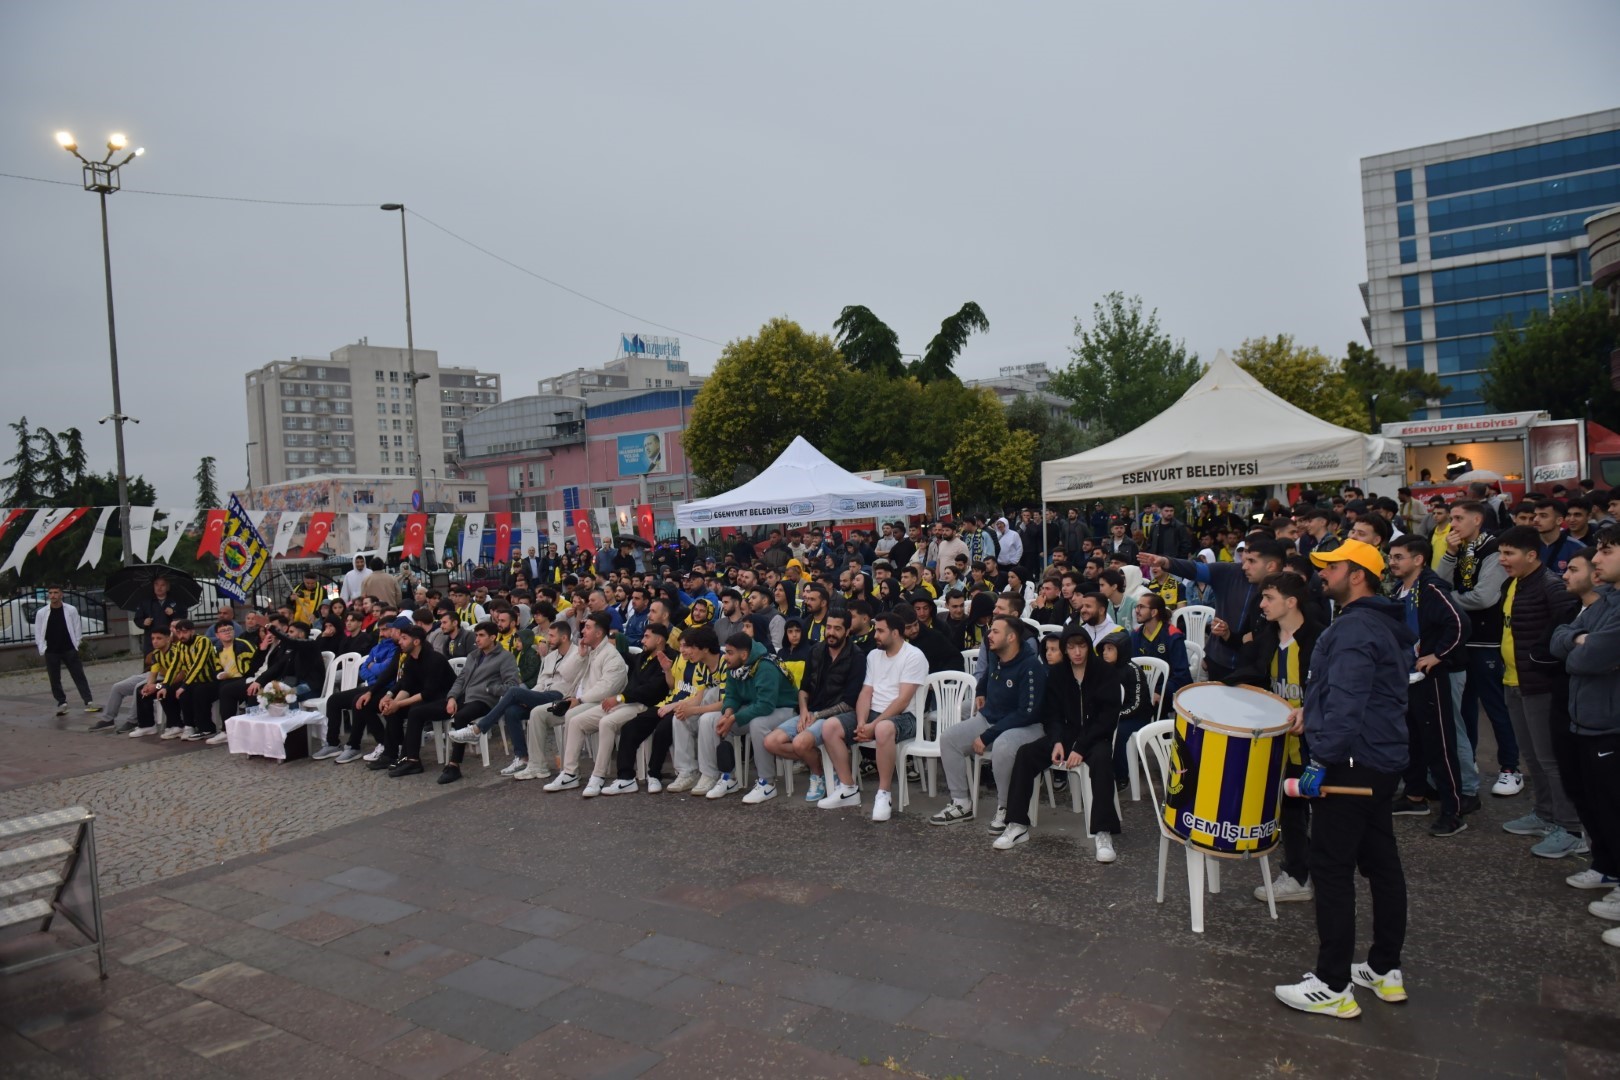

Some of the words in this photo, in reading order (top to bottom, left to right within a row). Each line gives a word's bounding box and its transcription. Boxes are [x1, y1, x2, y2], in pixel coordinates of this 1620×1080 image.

[1402, 424, 1454, 435] ESENYURT
[1456, 417, 1518, 431] BELEDİYESİ
[1122, 467, 1184, 485] ESENYURT
[1186, 459, 1259, 479] BELEDİYESİ
[713, 508, 748, 519] ESENYURT
[749, 505, 789, 517] BELEDİYESİ
[856, 500, 880, 510] ESENYURT
[880, 499, 904, 508] BELEDİYESİ
[1183, 812, 1220, 838] CEM
